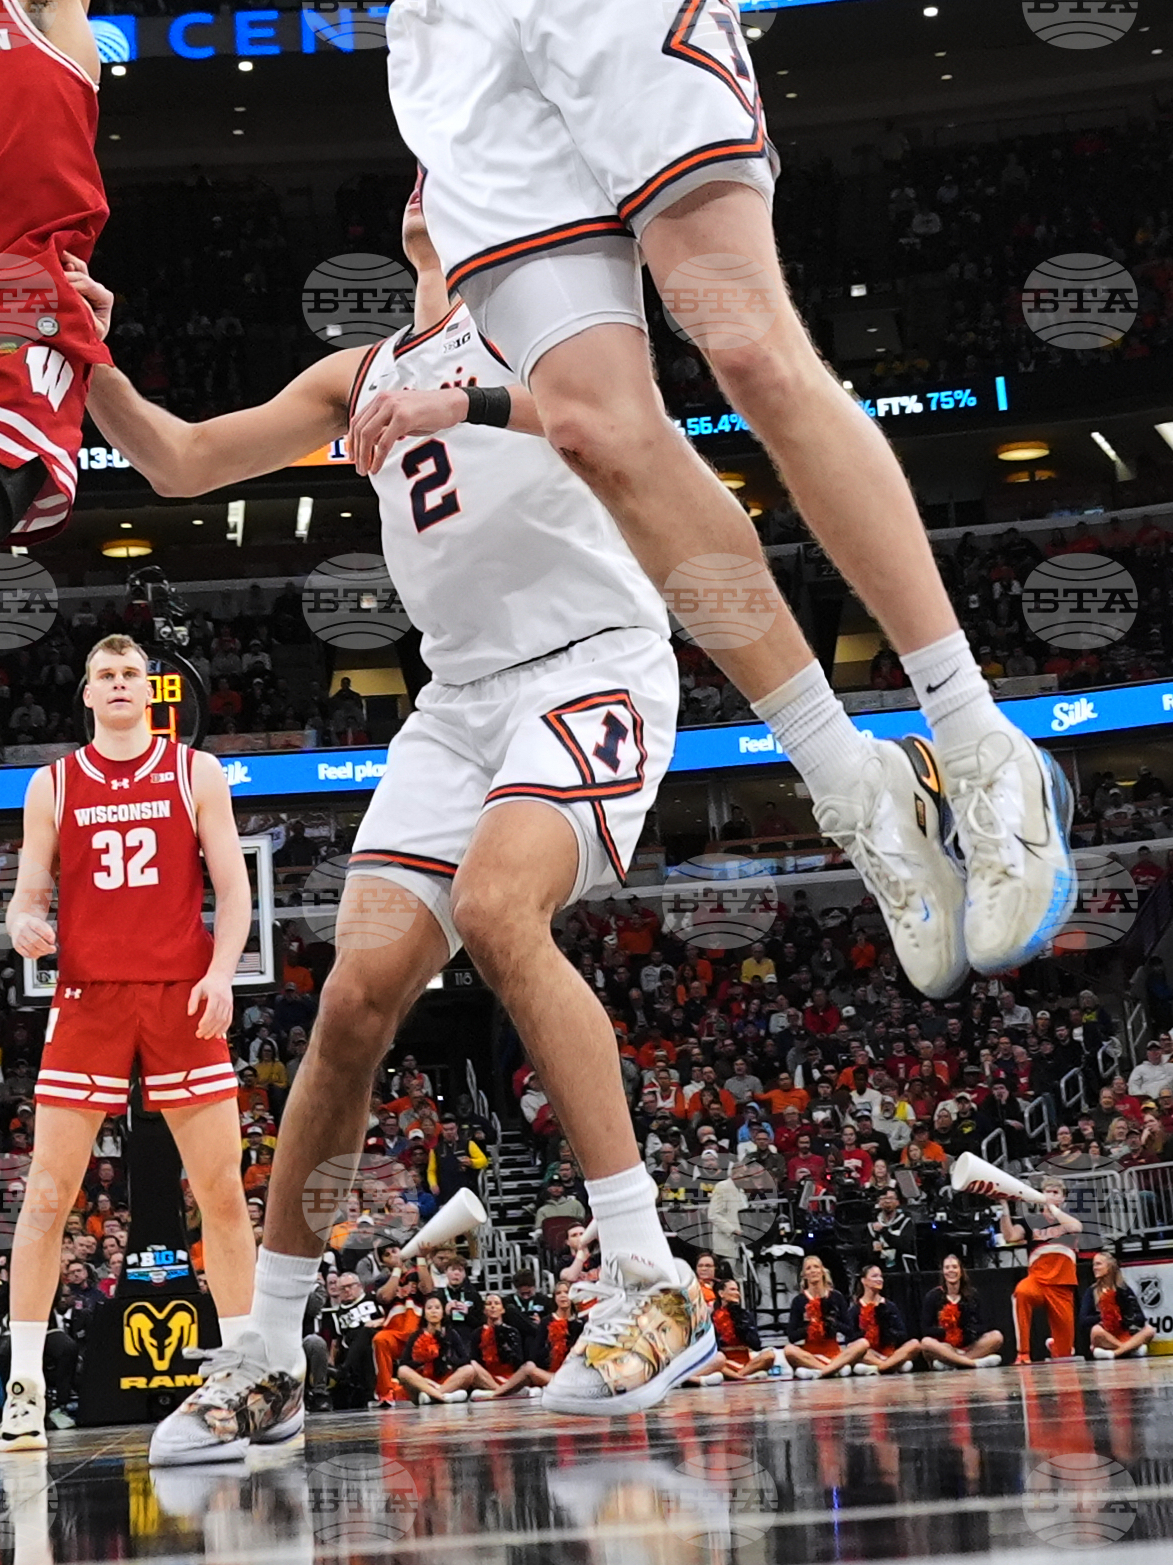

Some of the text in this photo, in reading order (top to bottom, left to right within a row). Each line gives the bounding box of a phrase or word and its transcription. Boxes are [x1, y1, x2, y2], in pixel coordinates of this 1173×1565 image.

[877, 396, 923, 417] FT%
[926, 389, 977, 411] 75%
[78, 447, 130, 470] 13:0
[401, 437, 461, 534] 2
[1050, 697, 1098, 731] Silk
[739, 736, 773, 754] Feel
[317, 762, 350, 782] Feel
[74, 800, 171, 827] WISCONSIN
[91, 827, 159, 890] 32
[120, 1373, 204, 1390] RAM
